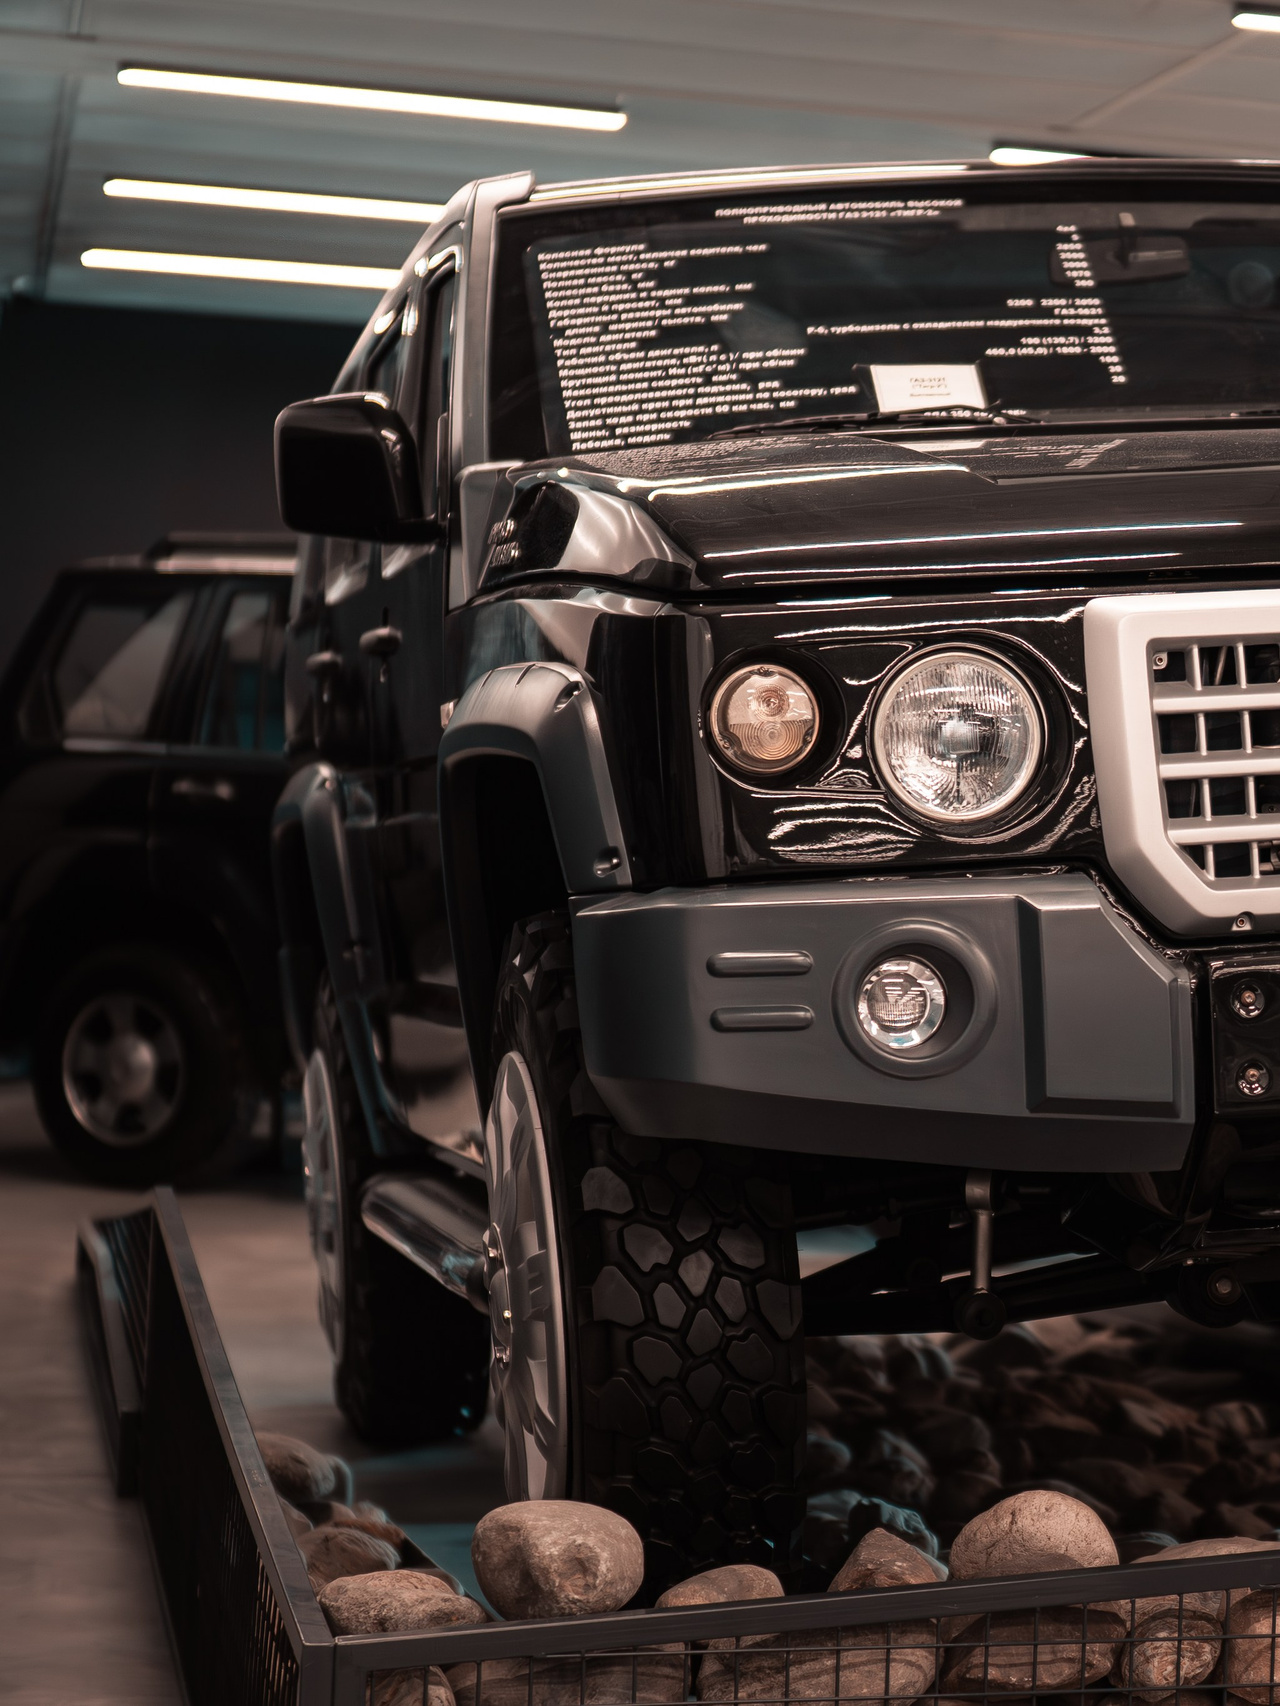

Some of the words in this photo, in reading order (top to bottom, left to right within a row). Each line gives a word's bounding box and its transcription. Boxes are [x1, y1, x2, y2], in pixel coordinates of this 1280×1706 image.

[829, 201, 905, 210] АВТОМОБИЛЬ
[907, 199, 962, 208] ВЫСОКОЙ
[744, 212, 837, 223] ПРОХОДИМОСТИ
[538, 249, 593, 260] Колесная
[594, 244, 645, 255] формула
[540, 257, 604, 270] Количество
[639, 250, 688, 259] включая
[690, 246, 743, 255] водителя,
[541, 266, 619, 279] Снаряженная
[620, 262, 658, 270] масса,
[543, 278, 585, 289] Полная
[588, 274, 625, 283] масса,
[545, 287, 600, 298] Колесная
[547, 298, 581, 308] Колея
[583, 293, 637, 303] передних
[650, 288, 690, 297] задних
[612, 301, 659, 310] просвет,
[550, 314, 618, 327] Габаритные
[621, 309, 672, 319] размеры
[609, 321, 653, 330] ширина
[554, 336, 596, 347] Модель
[599, 330, 656, 342] двигателя
[557, 355, 606, 367] Рабочий
[608, 351, 645, 361] объем
[648, 346, 708, 357] двигателя,
[580, 342, 636, 354] двигателя
[559, 365, 617, 377] Мощность
[620, 359, 680, 370] двигателя,
[742, 351, 764, 359] при
[561, 374, 617, 387] Крутящий
[739, 362, 760, 370] при
[563, 382, 648, 397] Максимальная
[651, 377, 703, 387] скорость
[564, 399, 591, 408] Угол
[594, 388, 695, 404] преодолеваемого
[567, 404, 639, 419] Допустимый
[642, 401, 669, 410] крен
[672, 398, 693, 407] при
[696, 393, 753, 405] движении
[830, 386, 856, 395] град
[569, 419, 602, 429] Запас
[606, 416, 633, 424] хода
[636, 413, 657, 421] при
[660, 407, 713, 418] скорости
[570, 430, 609, 439] Шины,
[615, 420, 691, 435] размерность
[572, 439, 625, 450] Лебедка,
[628, 433, 671, 443] модель
